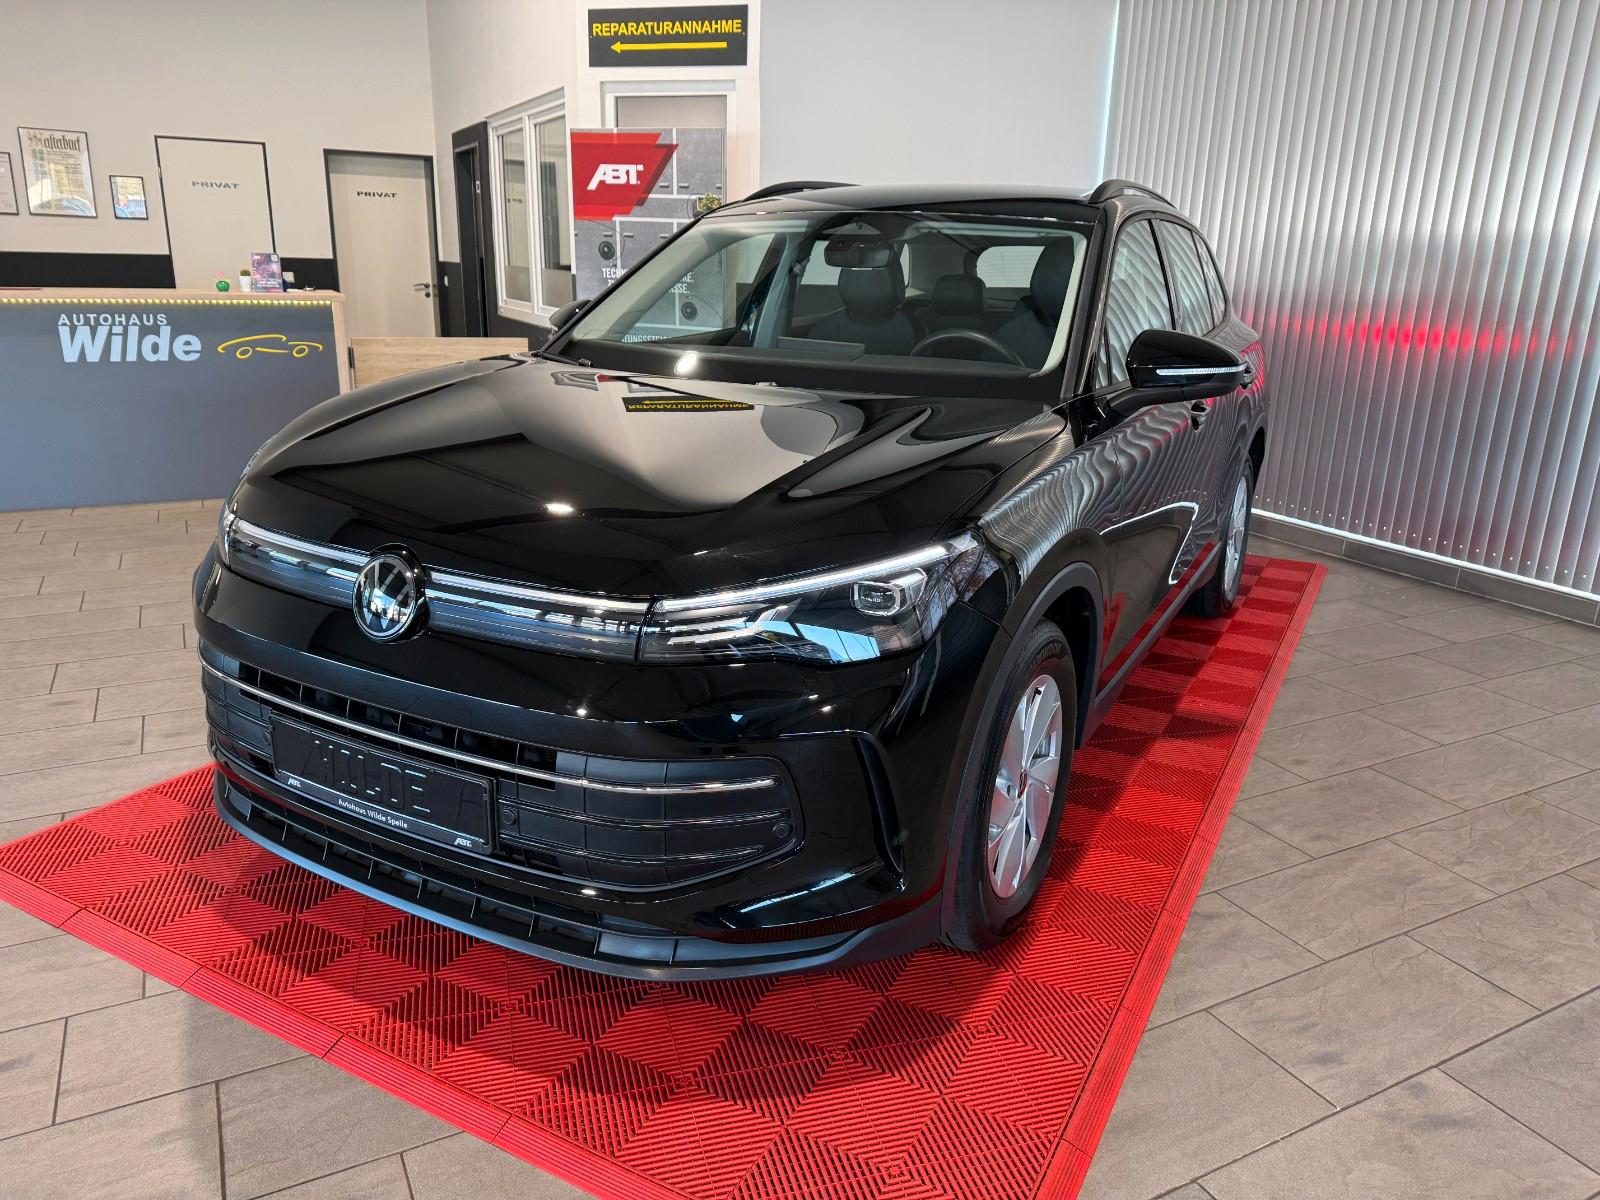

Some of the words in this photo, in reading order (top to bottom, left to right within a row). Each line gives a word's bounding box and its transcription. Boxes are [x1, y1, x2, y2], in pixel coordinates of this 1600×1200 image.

[592, 19, 742, 36] REPARATURANNAHME
[191, 180, 240, 189] PRIVAT
[586, 163, 644, 190] ABT
[57, 313, 168, 326] AUTOHAUS
[57, 325, 202, 362] Wilde
[338, 798, 367, 815] Autohaus
[367, 806, 386, 823] Wilde
[387, 814, 408, 829] Spelle
[454, 837, 473, 848] ABT
